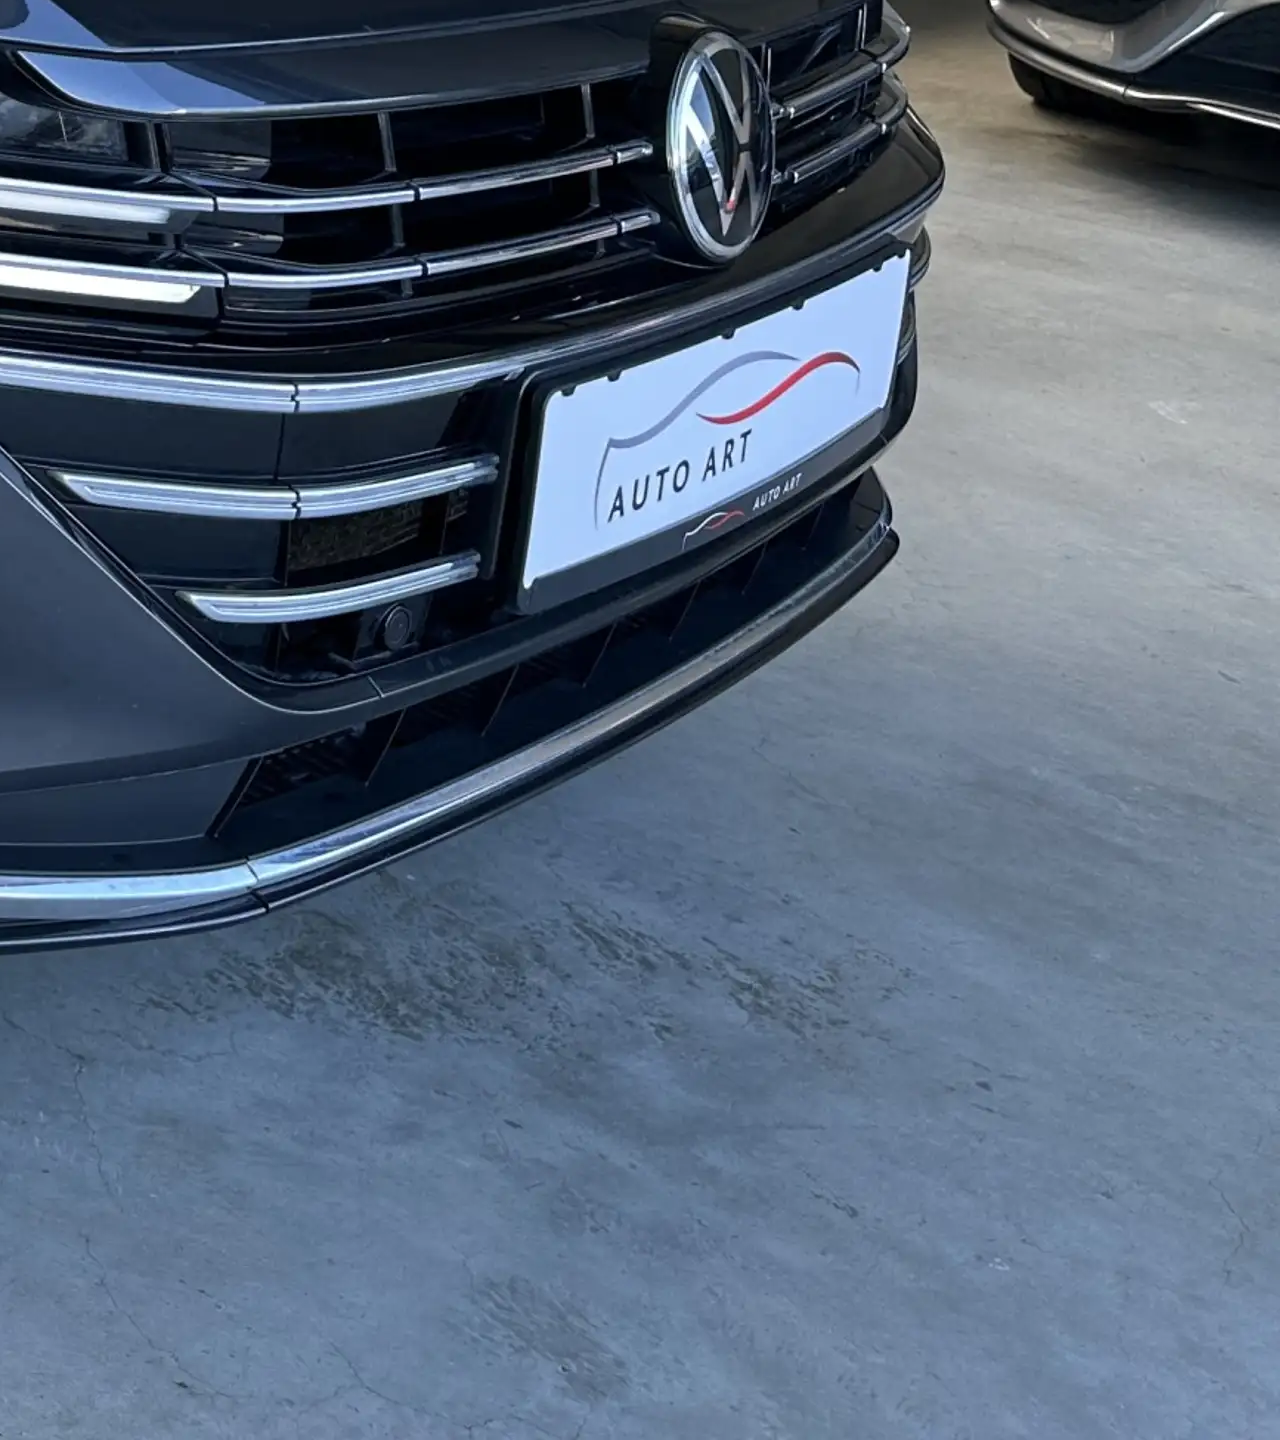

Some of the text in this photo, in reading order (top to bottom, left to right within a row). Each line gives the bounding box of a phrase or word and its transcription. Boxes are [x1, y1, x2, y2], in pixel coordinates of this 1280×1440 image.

[607, 428, 753, 523] AUTO ART
[752, 472, 803, 511] AUTO ART
